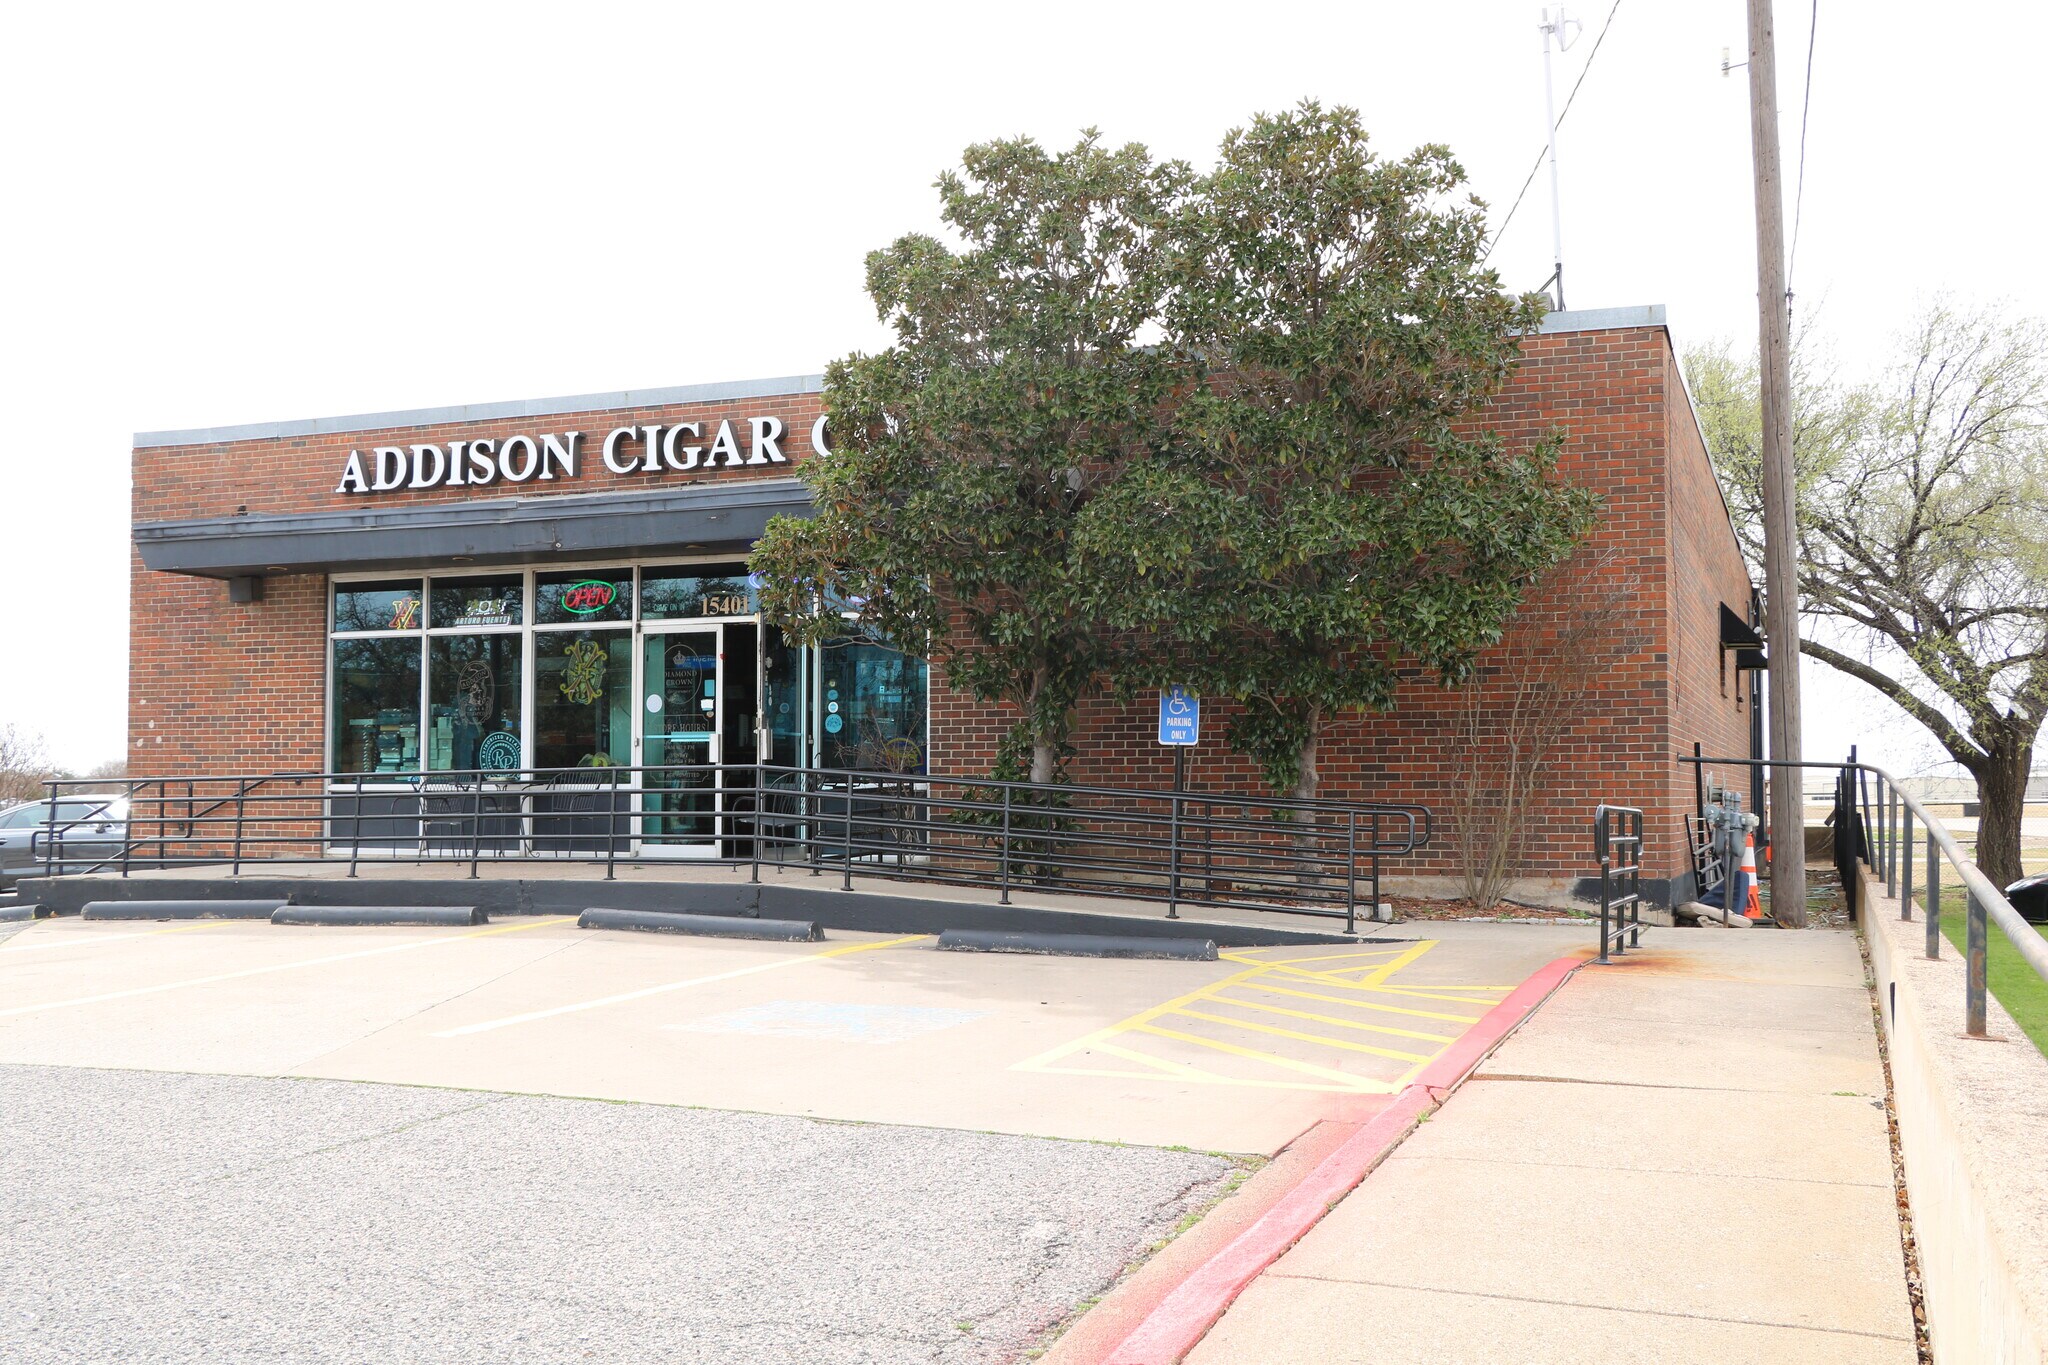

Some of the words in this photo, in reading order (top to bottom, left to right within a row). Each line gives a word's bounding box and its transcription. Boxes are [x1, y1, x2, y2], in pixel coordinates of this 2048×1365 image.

[336, 431, 583, 494] ADDISON
[603, 415, 788, 475] CIGAR
[566, 588, 611, 607] OPEN
[701, 594, 749, 616] 15401
[455, 617, 481, 625] ARTURO
[481, 616, 507, 624] FUENTE
[679, 723, 706, 732] HOURS
[1167, 718, 1191, 726] PARKING
[1171, 731, 1186, 740] ONLY
[482, 734, 504, 758] AUTHORIZED
